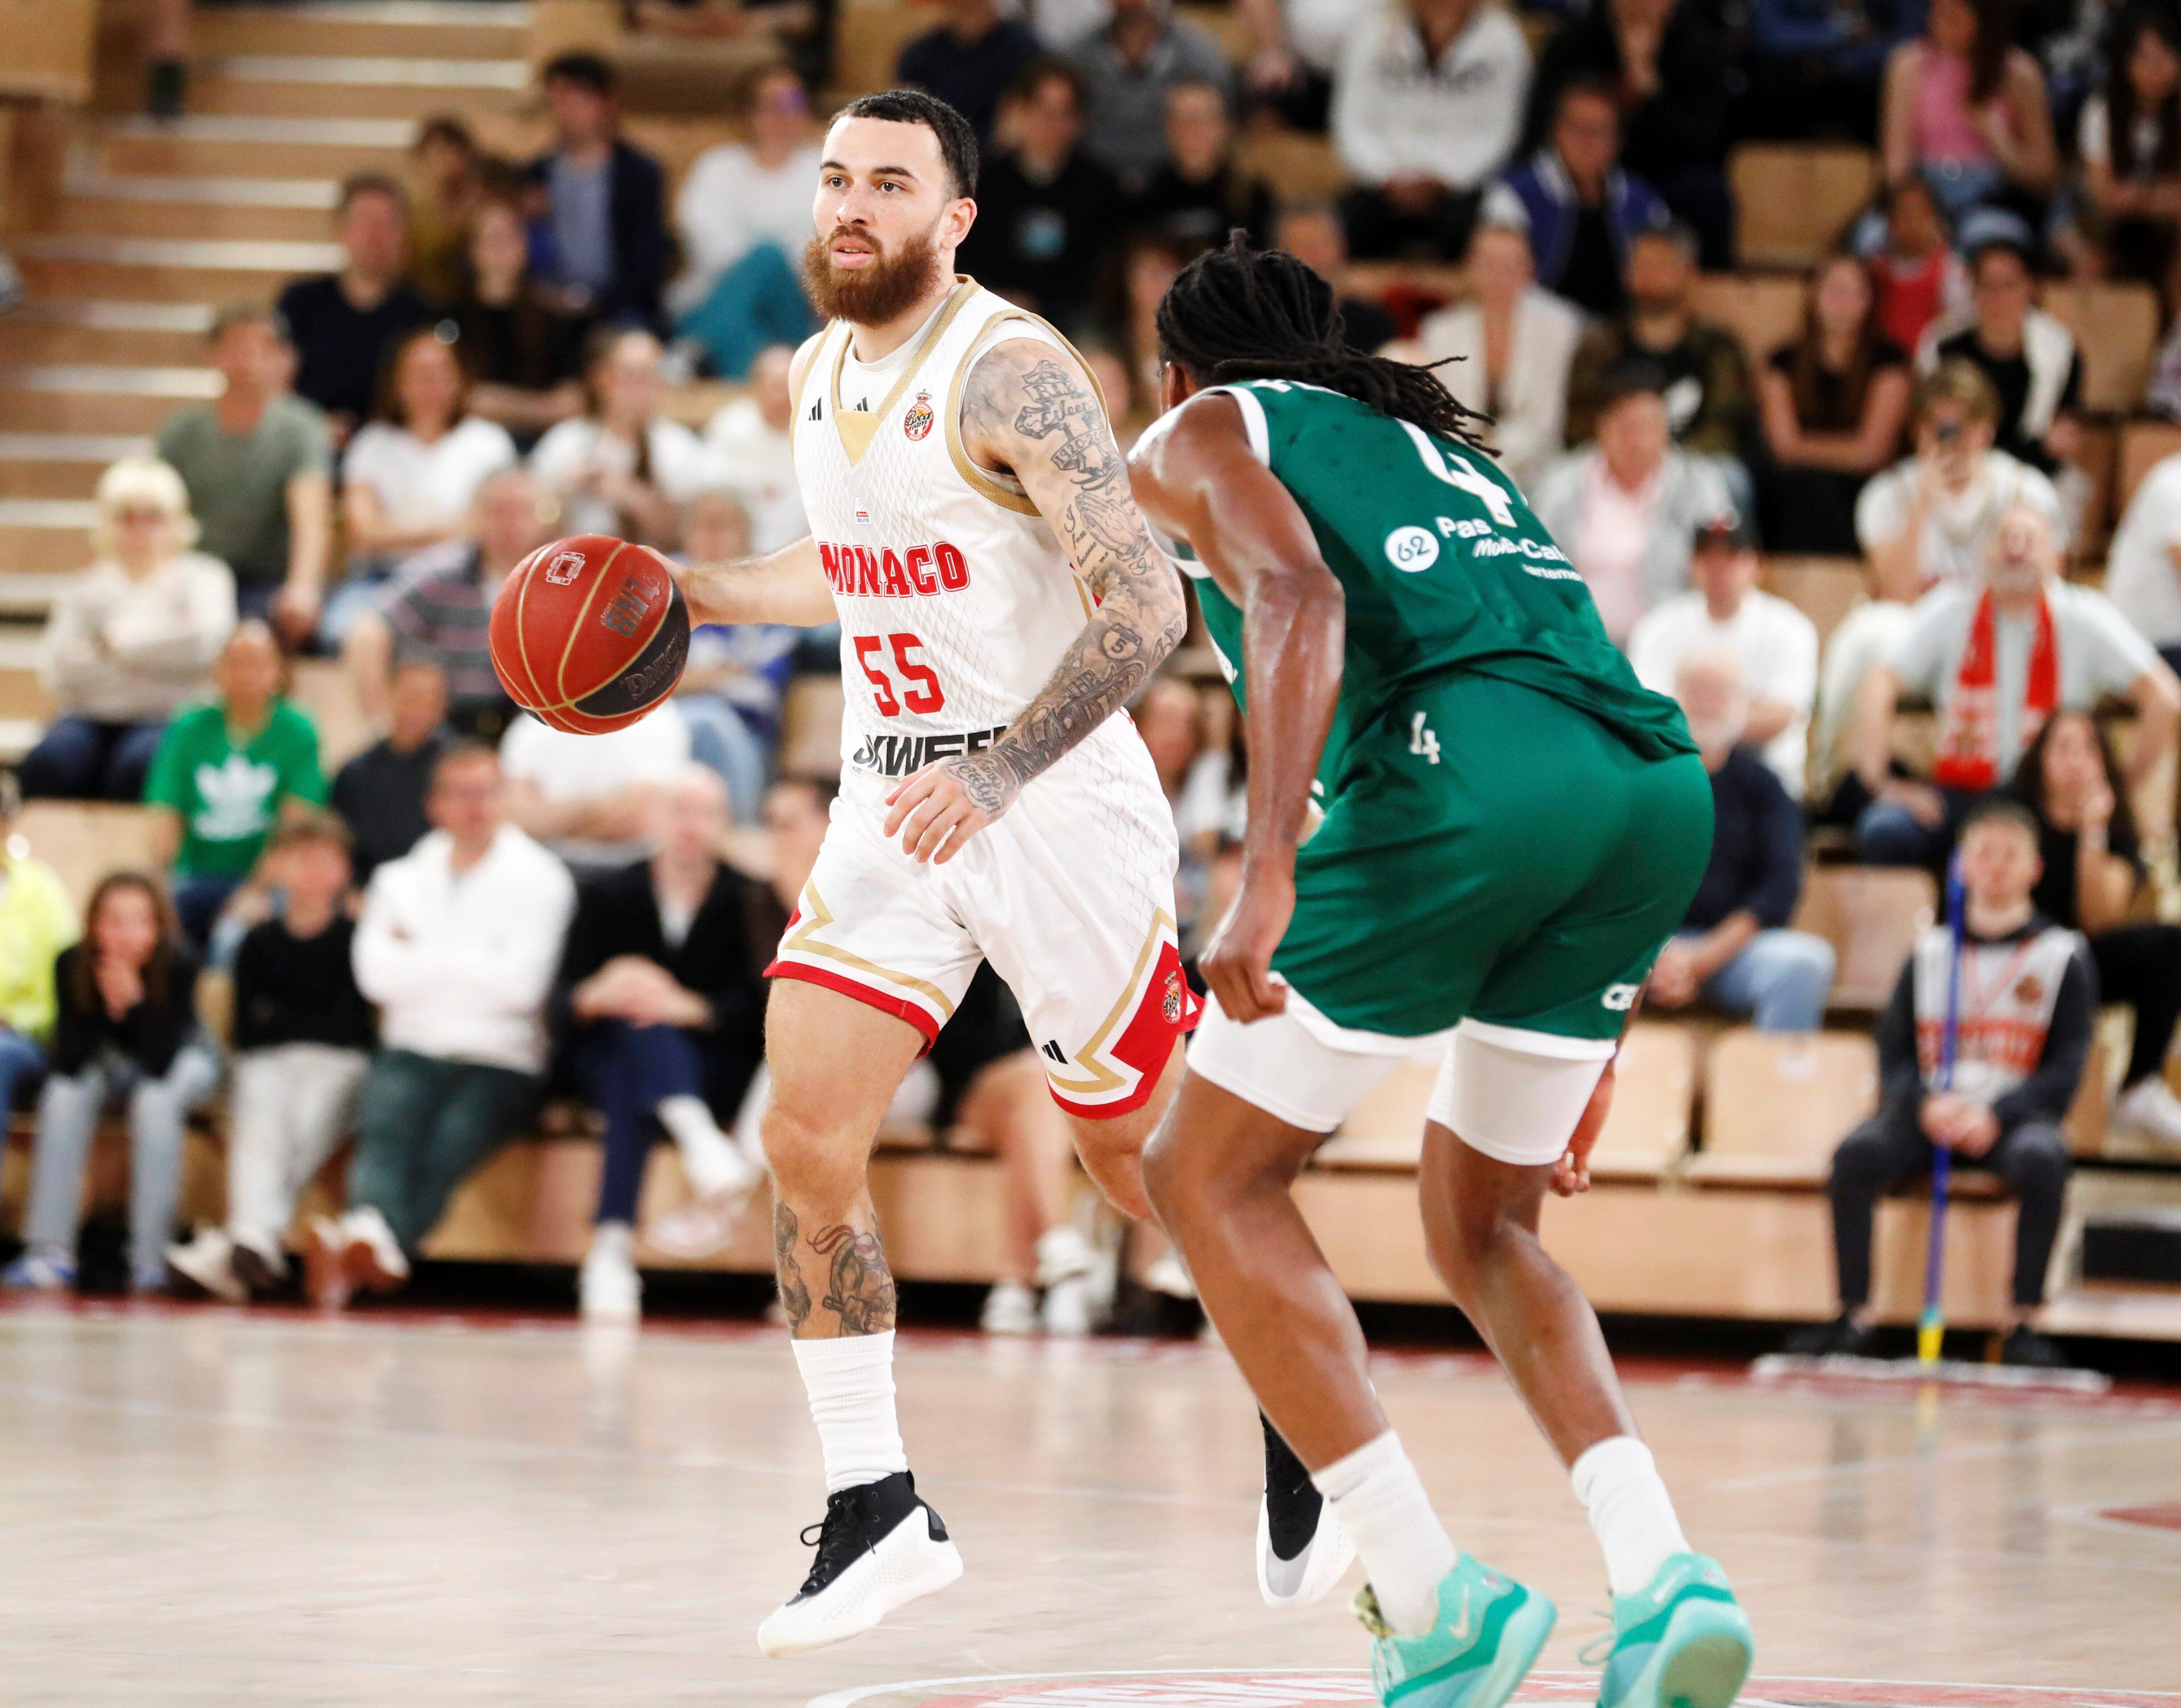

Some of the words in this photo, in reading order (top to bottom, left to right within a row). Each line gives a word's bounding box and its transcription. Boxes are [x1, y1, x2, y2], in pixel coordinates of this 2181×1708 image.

[819, 541, 970, 598] MONACO
[1398, 535, 1431, 562] 62
[853, 633, 945, 716] 55
[1410, 711, 1440, 764] 4
